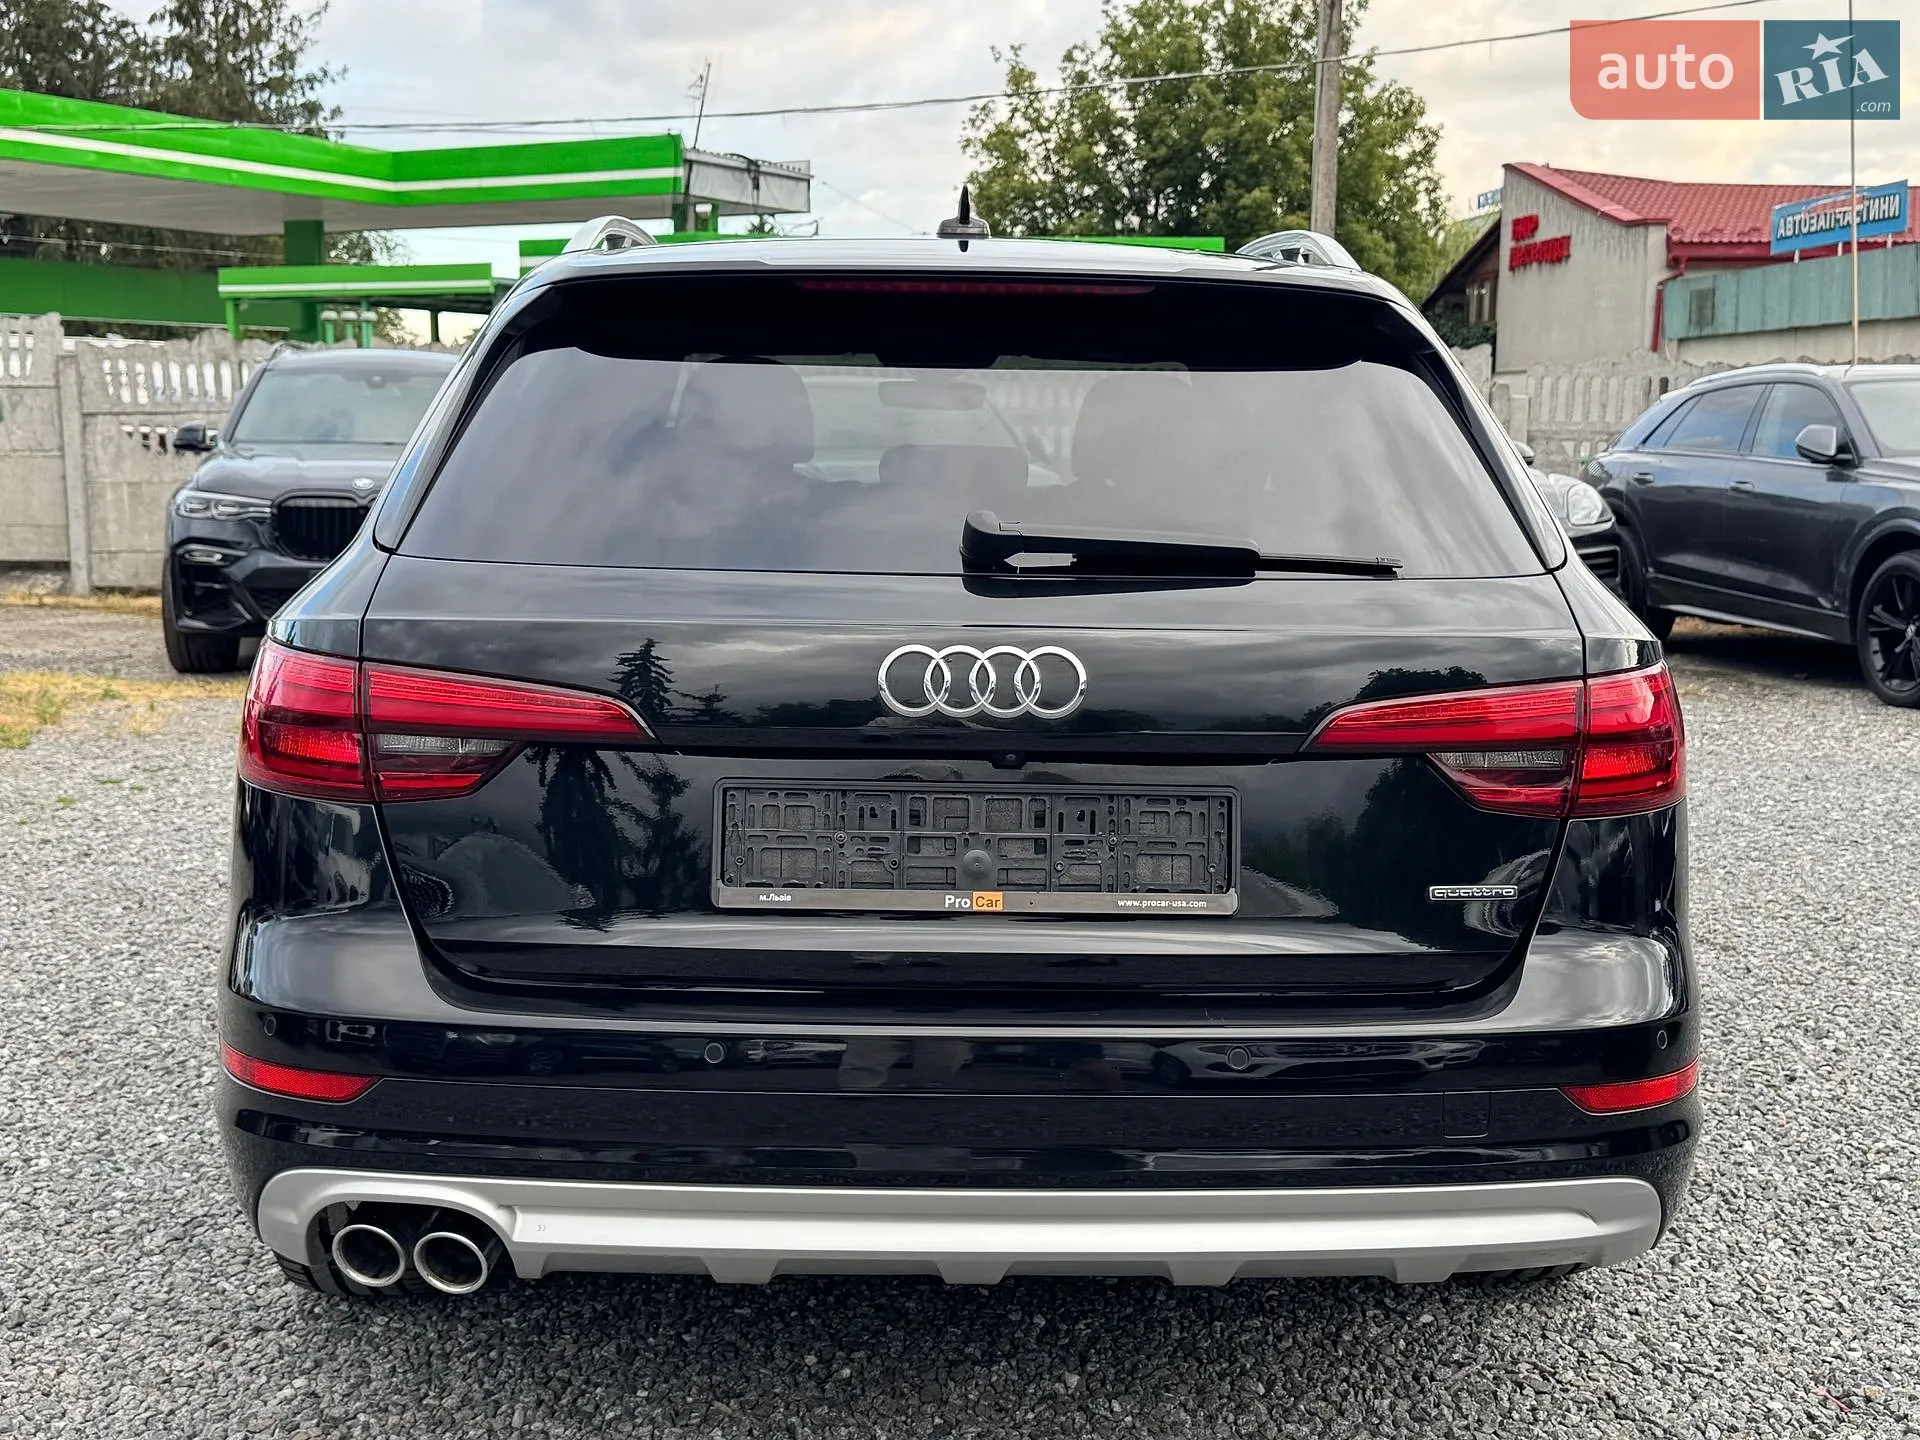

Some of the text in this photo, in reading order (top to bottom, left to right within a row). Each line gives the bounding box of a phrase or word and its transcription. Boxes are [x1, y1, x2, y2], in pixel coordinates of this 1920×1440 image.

[1434, 887, 1514, 898] quattro
[945, 894, 1000, 908] Pro Car
[1117, 899, 1207, 908] www.procar-usa.com
